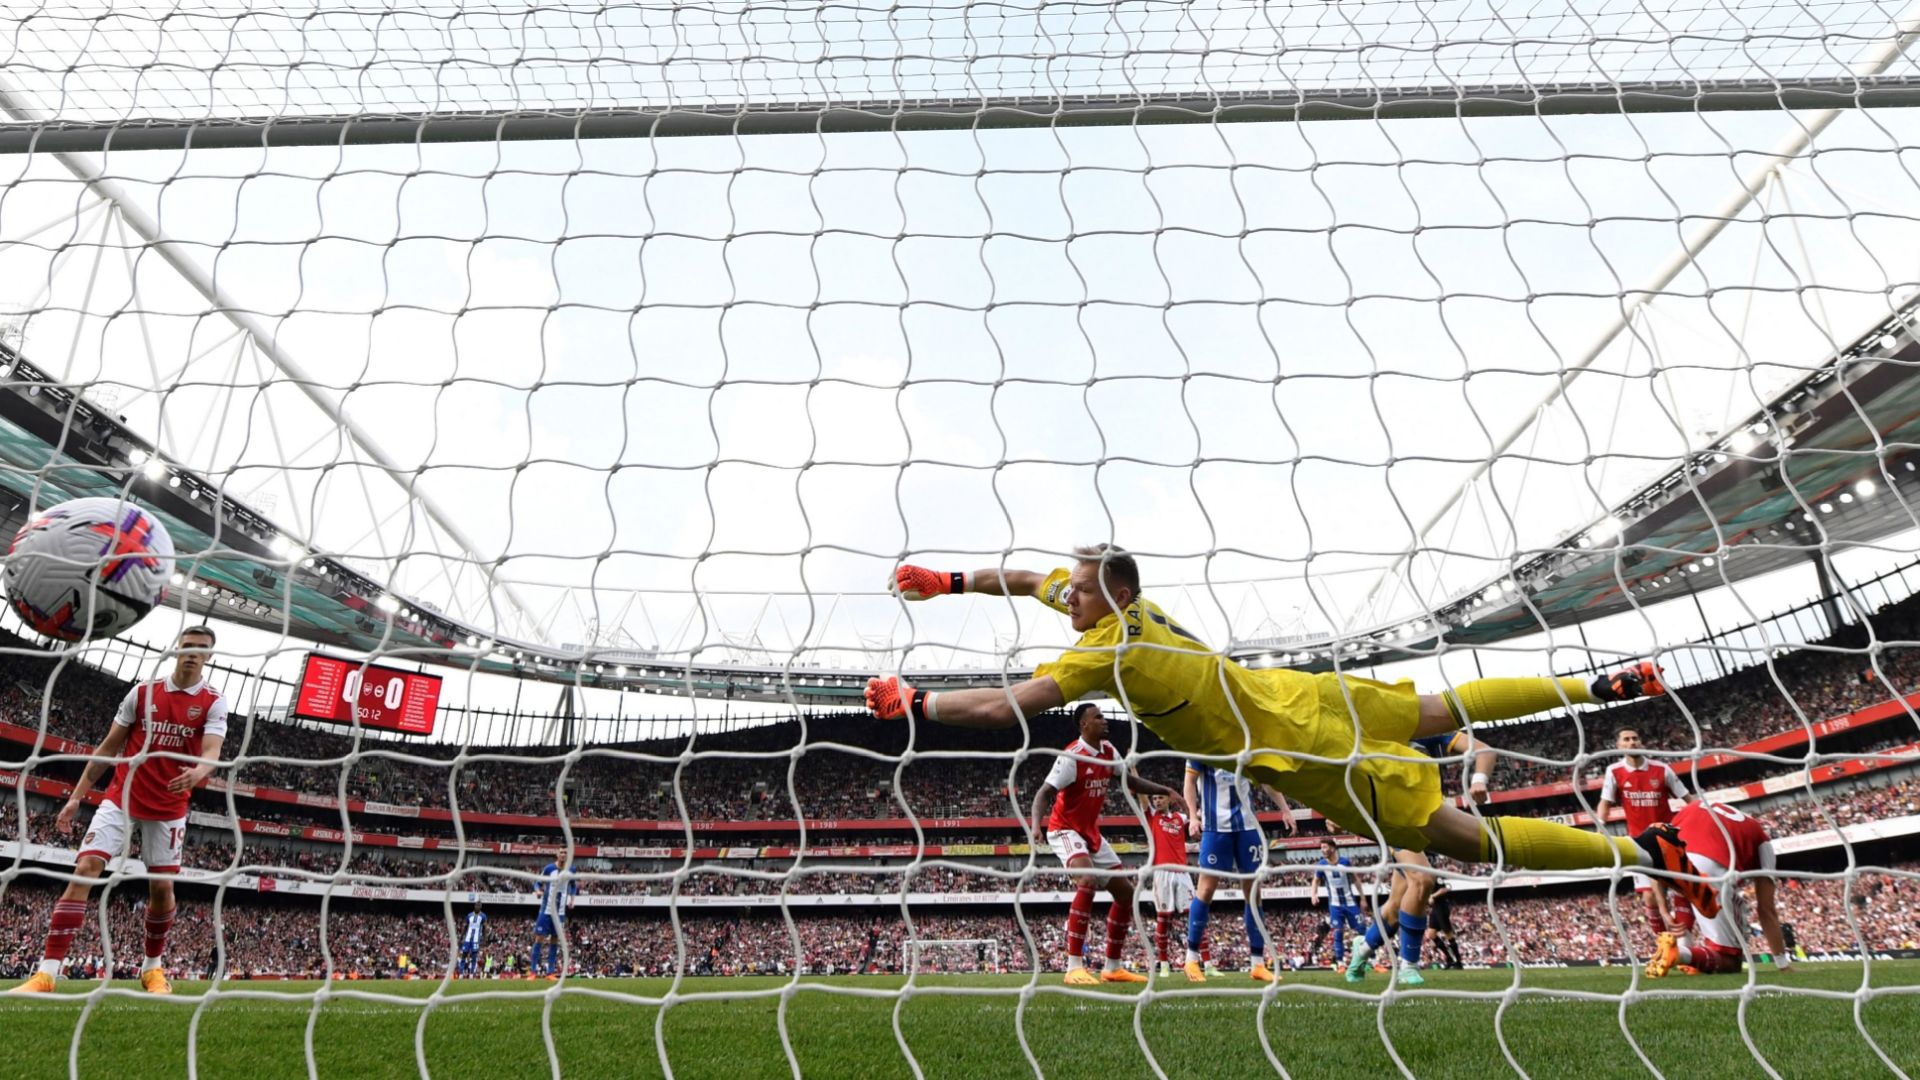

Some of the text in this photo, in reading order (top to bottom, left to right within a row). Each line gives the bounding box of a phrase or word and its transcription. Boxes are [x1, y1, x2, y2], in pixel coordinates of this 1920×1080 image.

[384, 677, 404, 710] 0
[1623, 790, 1662, 800] Emirates
[253, 823, 291, 836] Arsenal.co
[696, 822, 715, 830] 1987
[942, 820, 961, 828] 1991
[168, 826, 185, 850] 19
